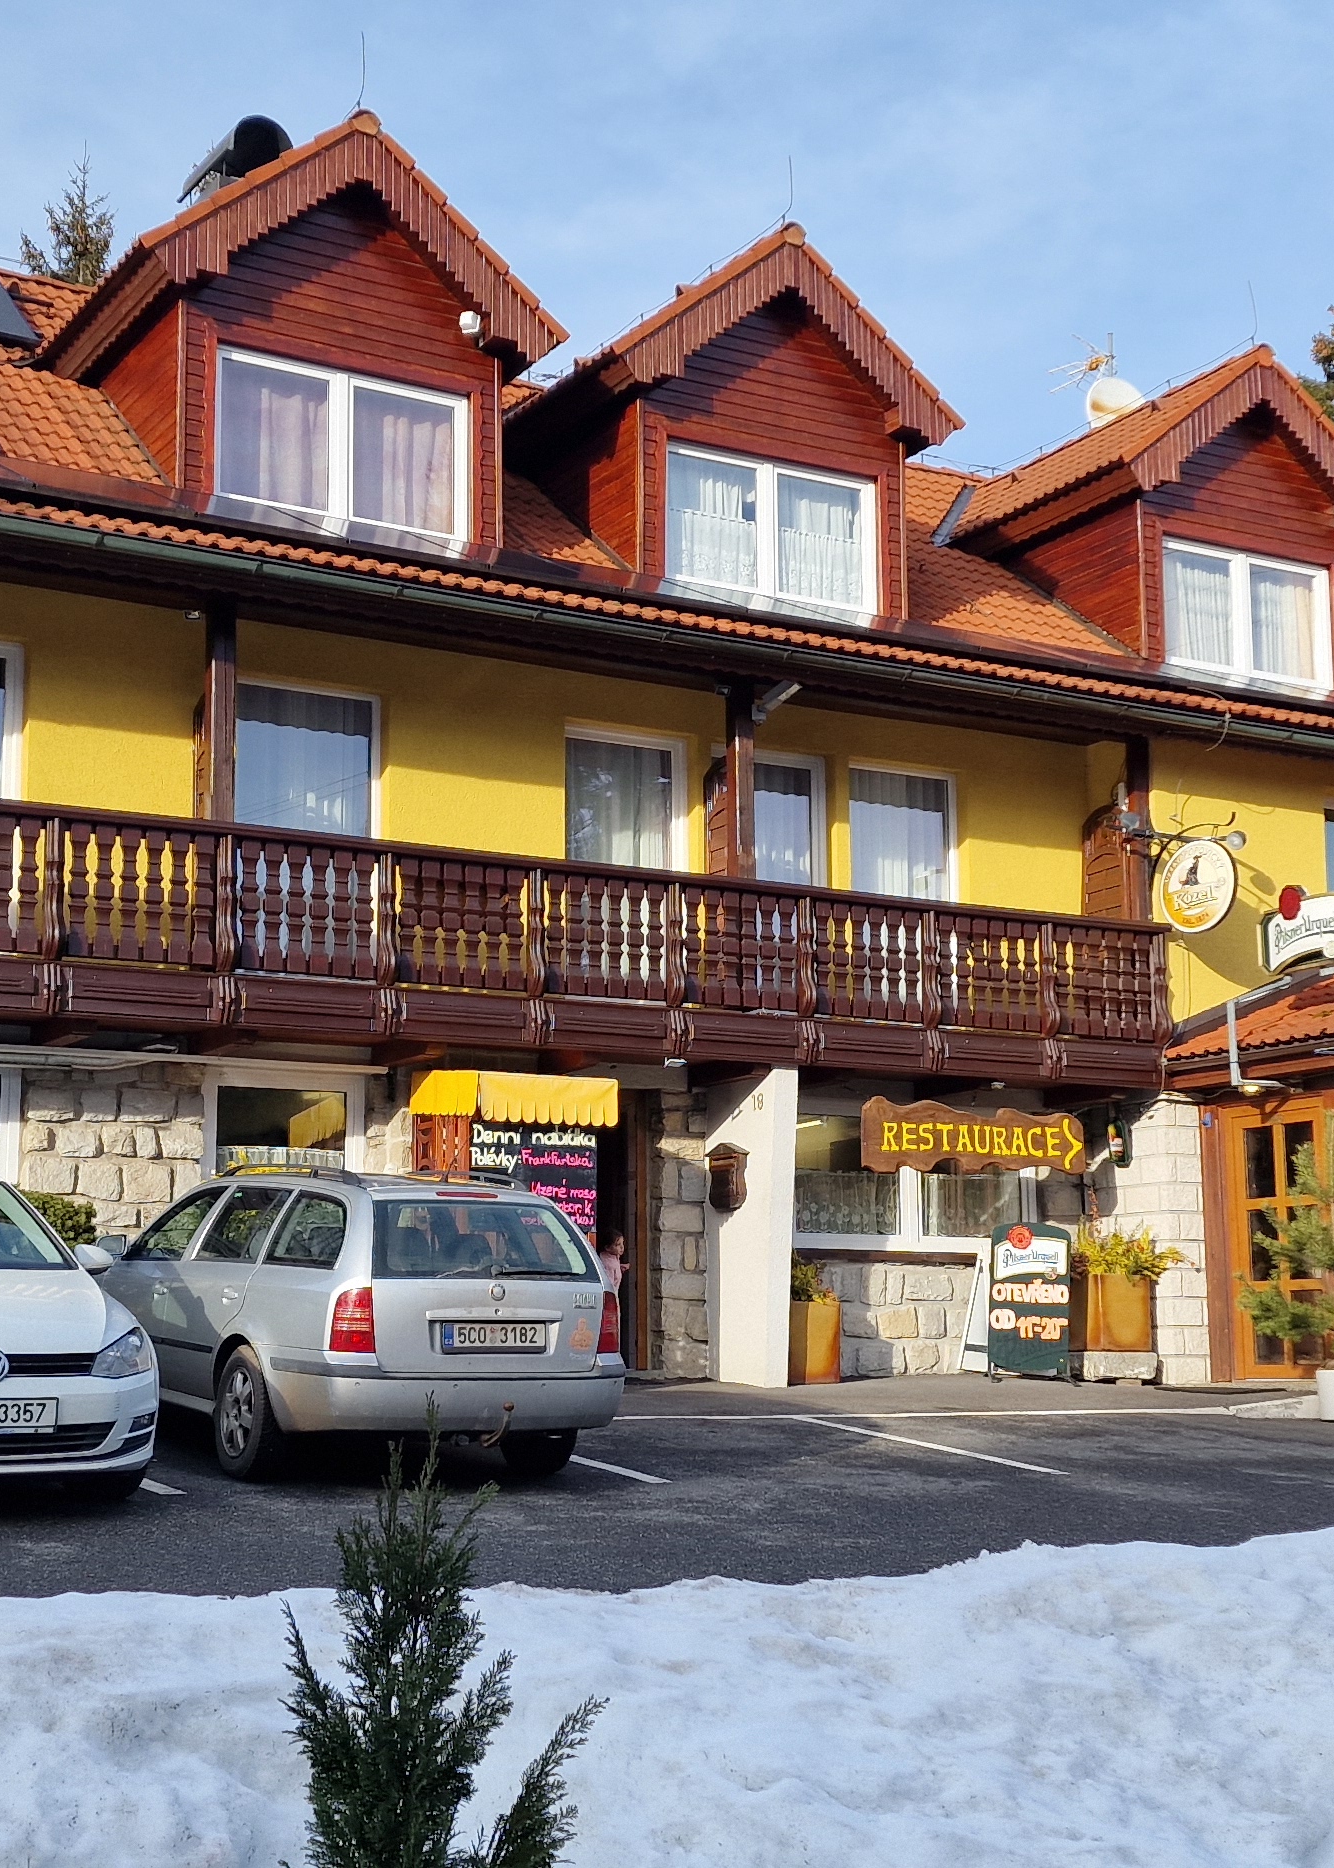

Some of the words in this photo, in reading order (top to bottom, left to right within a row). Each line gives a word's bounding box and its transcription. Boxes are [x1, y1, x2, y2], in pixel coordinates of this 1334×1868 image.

[1174, 886, 1217, 911] Kozel
[1274, 922, 1304, 954] Pilsner
[752, 1093, 764, 1111] 18
[881, 1121, 1063, 1158] RESTAURACE
[992, 1279, 1070, 1304] OTEVŘENO
[990, 1308, 1016, 1330] OD
[500, 1327, 538, 1344] 3182
